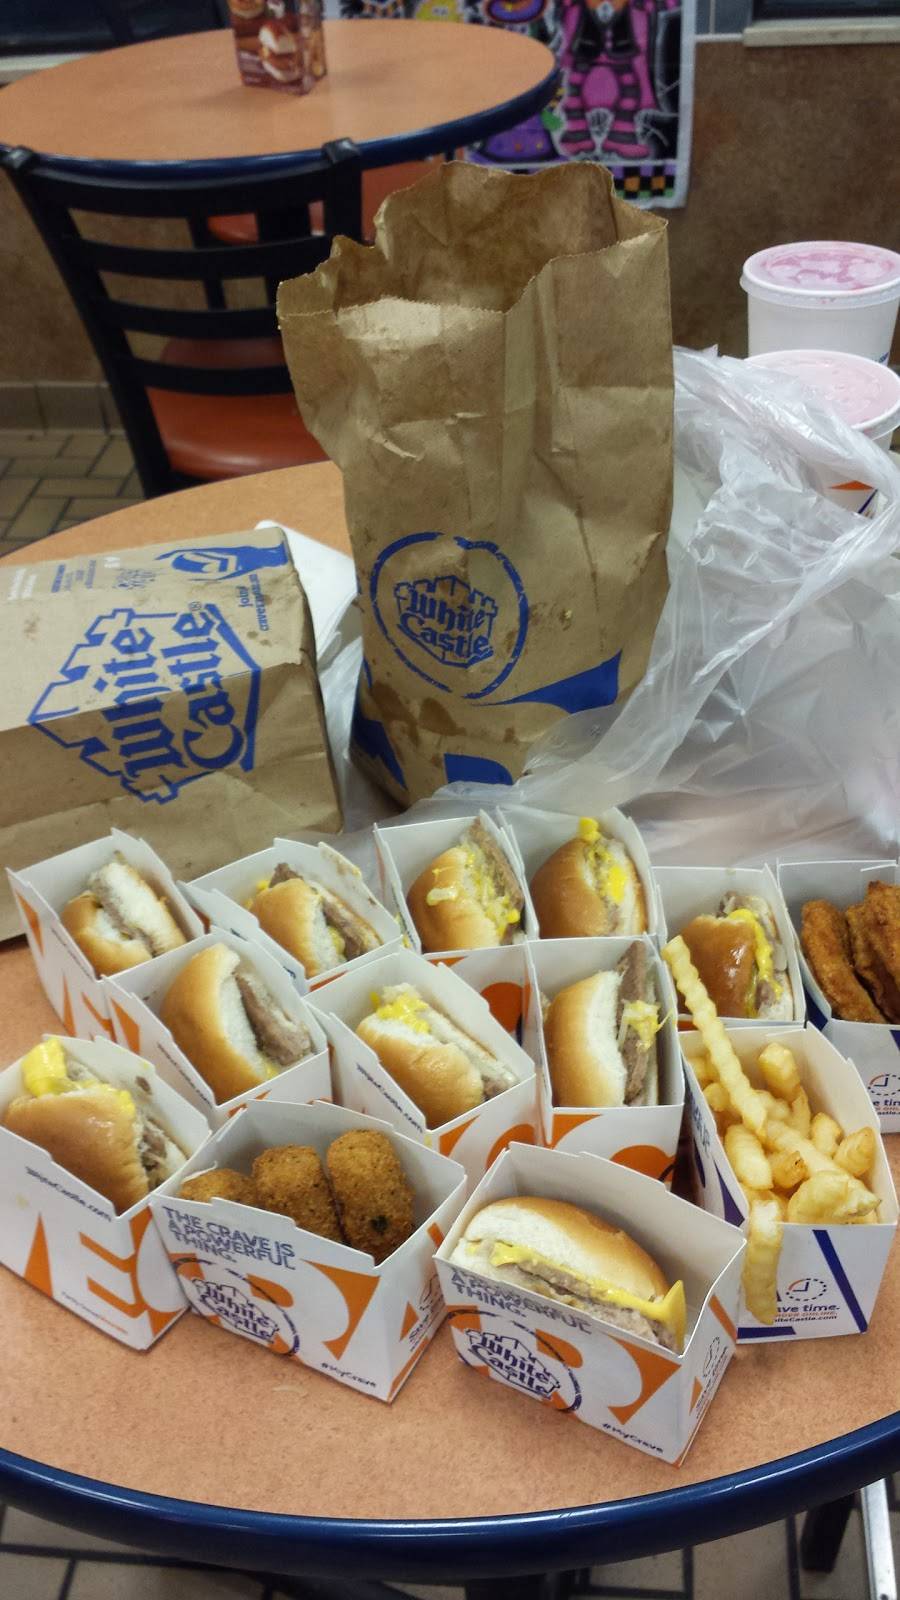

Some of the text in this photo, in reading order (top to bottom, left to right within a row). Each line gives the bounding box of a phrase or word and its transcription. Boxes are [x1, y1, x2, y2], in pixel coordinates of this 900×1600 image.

[404, 588, 486, 632] White
[400, 611, 492, 658] Castle
[93, 627, 188, 779] White
[161, 611, 244, 770] Castle
[162, 1206, 295, 1259] THE CRAVE IS
[183, 1225, 297, 1271] POWERFUL
[451, 1271, 466, 1287] A
[455, 1283, 527, 1318] THING.
[199, 1282, 272, 1328] White
[200, 1294, 275, 1341] Castle
[470, 1344, 554, 1395] Castle
[479, 1333, 552, 1383] White
